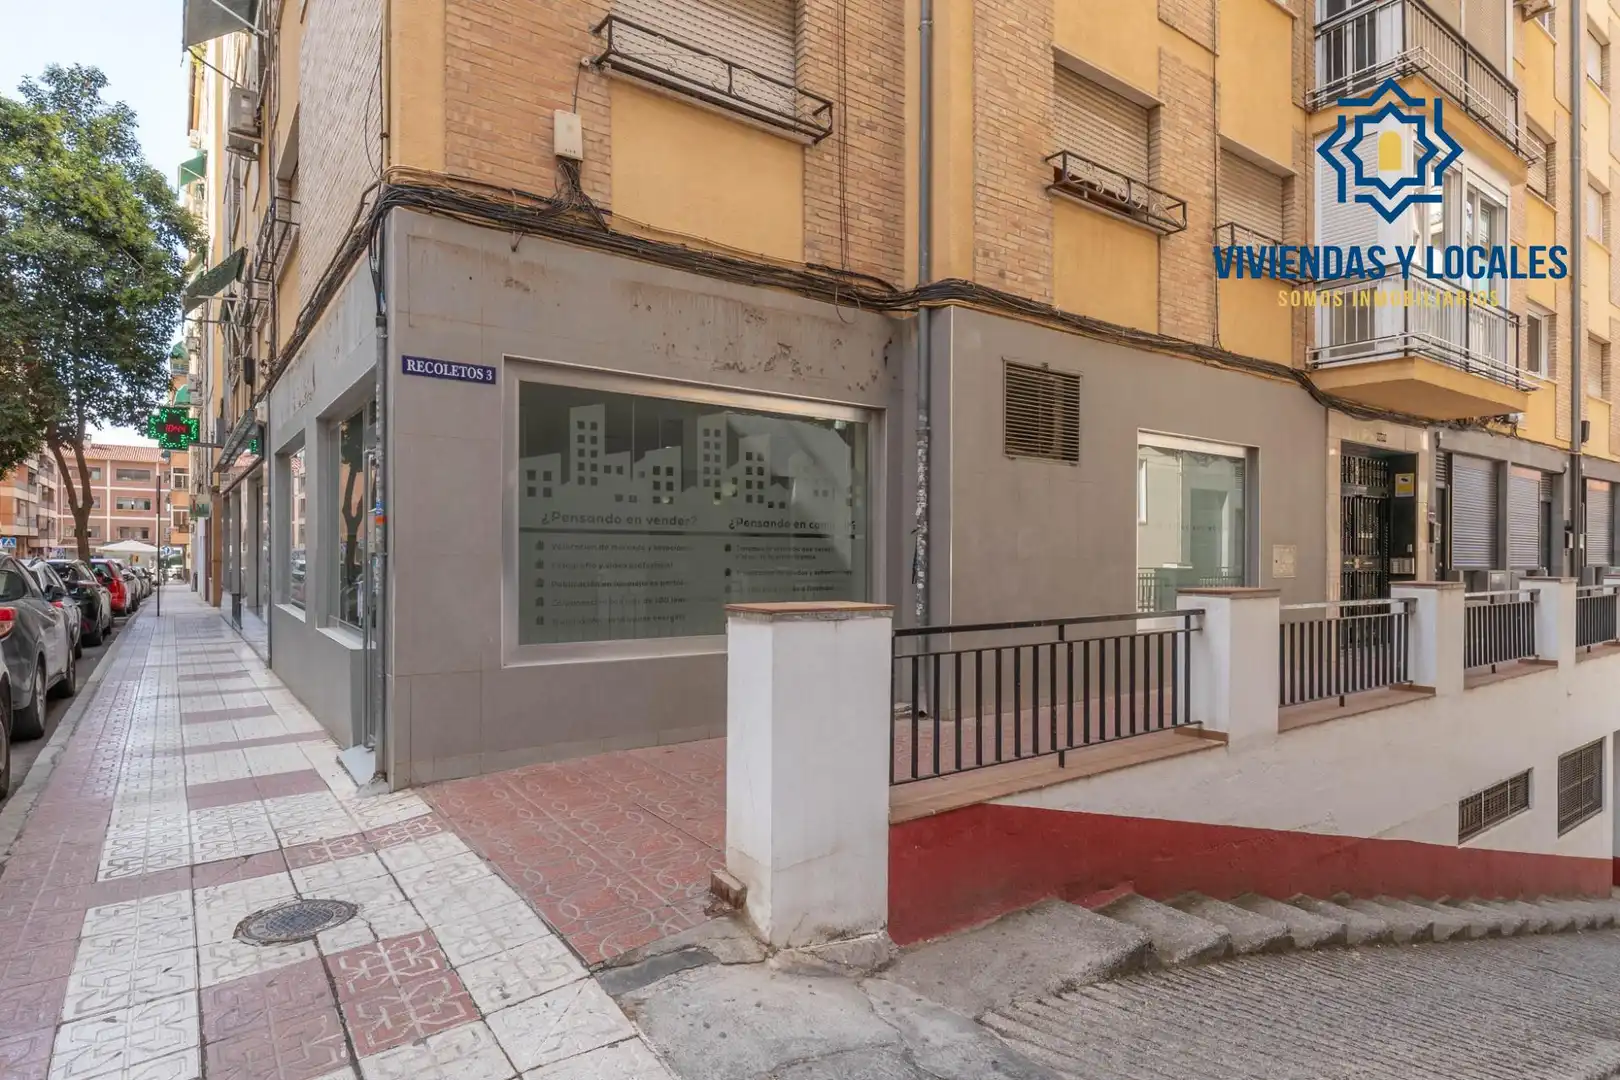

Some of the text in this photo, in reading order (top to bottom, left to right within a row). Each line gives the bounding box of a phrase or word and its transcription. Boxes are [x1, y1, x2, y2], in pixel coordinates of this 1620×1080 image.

[406, 358, 493, 381] RECOLETOS 3
[541, 510, 699, 527] ¿Pensando en vender?
[792, 519, 807, 530] en
